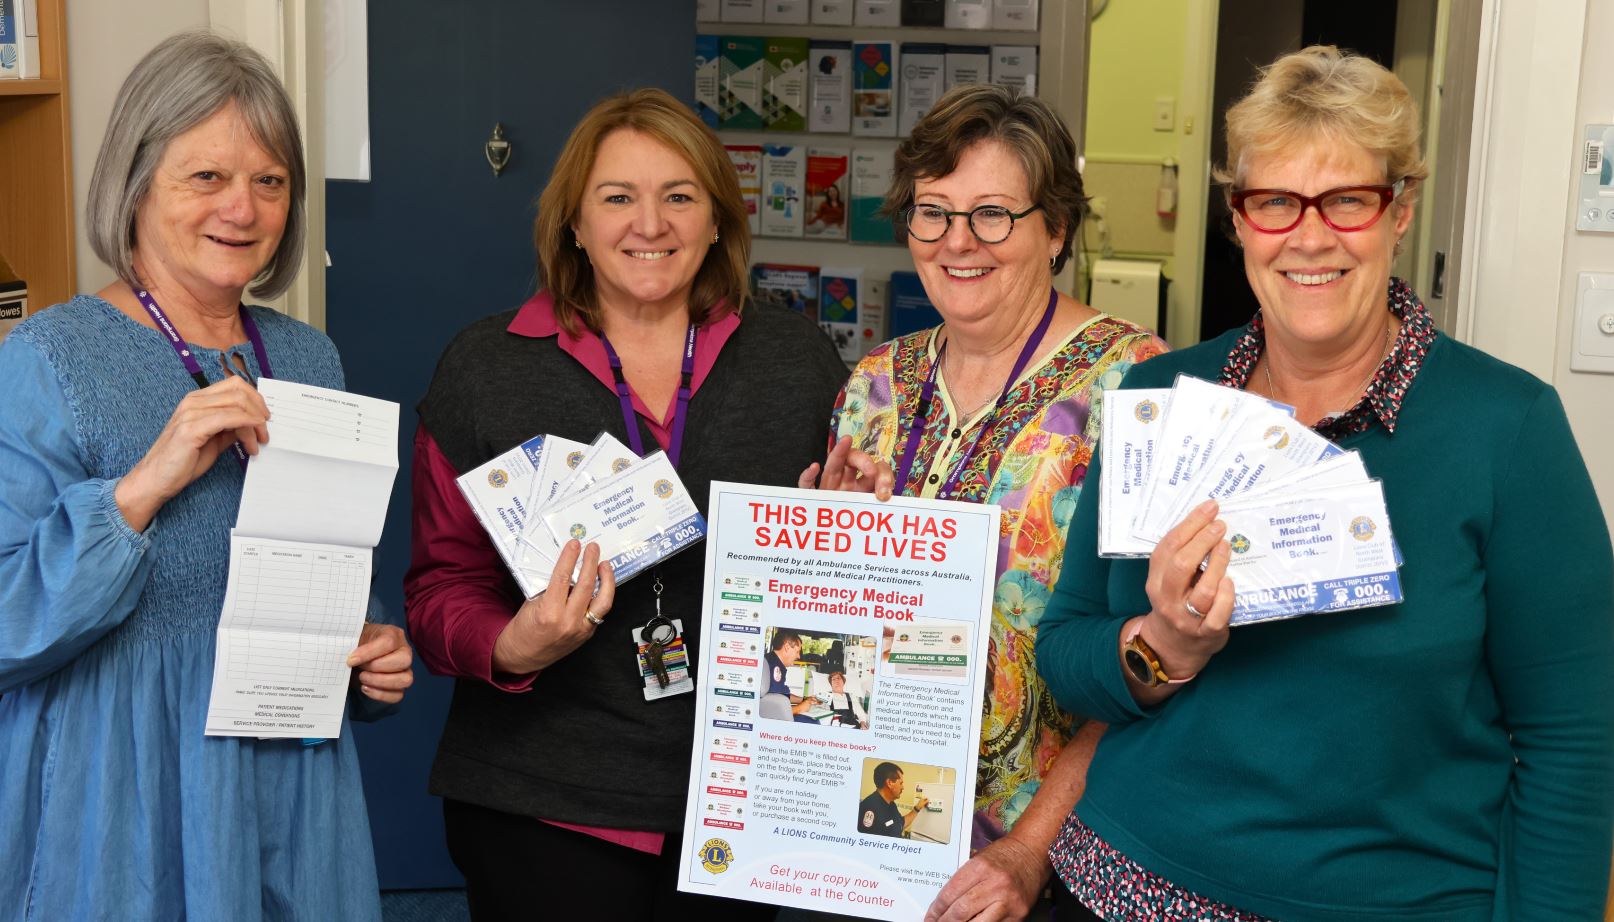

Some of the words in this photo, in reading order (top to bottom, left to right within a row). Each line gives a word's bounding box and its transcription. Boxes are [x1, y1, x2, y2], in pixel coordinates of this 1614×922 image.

[0, 307, 20, 318] owes
[1208, 453, 1244, 500] Emergecy
[593, 486, 633, 510] Emergency
[604, 496, 633, 515] Medical
[507, 508, 524, 532] edical
[601, 502, 645, 527] Information
[617, 516, 639, 529] Book.
[748, 502, 806, 526] THIS
[816, 508, 893, 533] BOOK
[902, 514, 956, 538] HAS
[1269, 513, 1325, 526] Emergency
[650, 534, 665, 544] CALL
[664, 524, 683, 537] TRIPLE
[682, 516, 698, 527] ZERO
[674, 523, 700, 542] 000.
[1280, 523, 1320, 536] Medical
[672, 531, 704, 550] ASSISTANCE
[755, 526, 851, 552] SAVED
[864, 535, 945, 561] LIVES
[1272, 535, 1332, 549] Information
[726, 552, 789, 563] Recommended
[816, 559, 861, 569] Ambulance
[864, 564, 898, 573] Services
[931, 570, 971, 581] Australia,
[773, 566, 812, 575] Hospitals
[833, 571, 865, 580] Medical
[867, 574, 923, 585] Practitioners.
[1324, 581, 1343, 590] CALL
[1345, 577, 1368, 588] TRIPLE
[1369, 574, 1390, 584] ZERO
[768, 579, 857, 601] Emergency
[862, 588, 922, 606] Medical
[1354, 582, 1389, 599] 000.
[777, 595, 867, 616] Information
[873, 605, 913, 621] Book
[1347, 593, 1390, 607] ASSISTANCE
[877, 689, 914, 698] Information
[902, 701, 938, 710] information
[917, 720, 953, 729] ambulance
[809, 738, 826, 746] keep
[849, 743, 876, 752] books?
[874, 732, 911, 741] transported
[806, 768, 843, 779] Paramedics
[795, 790, 817, 799] holiday
[707, 838, 727, 848] LIONS
[781, 828, 806, 838] LIONS
[809, 831, 856, 846] Community
[858, 838, 888, 849] Service
[891, 842, 921, 853] Project
[712, 849, 722, 862] L
[770, 864, 790, 876] Get
[793, 870, 819, 880] your
[822, 874, 850, 886] copy
[854, 878, 878, 888] now
[879, 864, 898, 872] Please
[750, 877, 801, 894] Available
[810, 887, 820, 896] at
[825, 888, 842, 899] the
[847, 891, 894, 906] Counter
